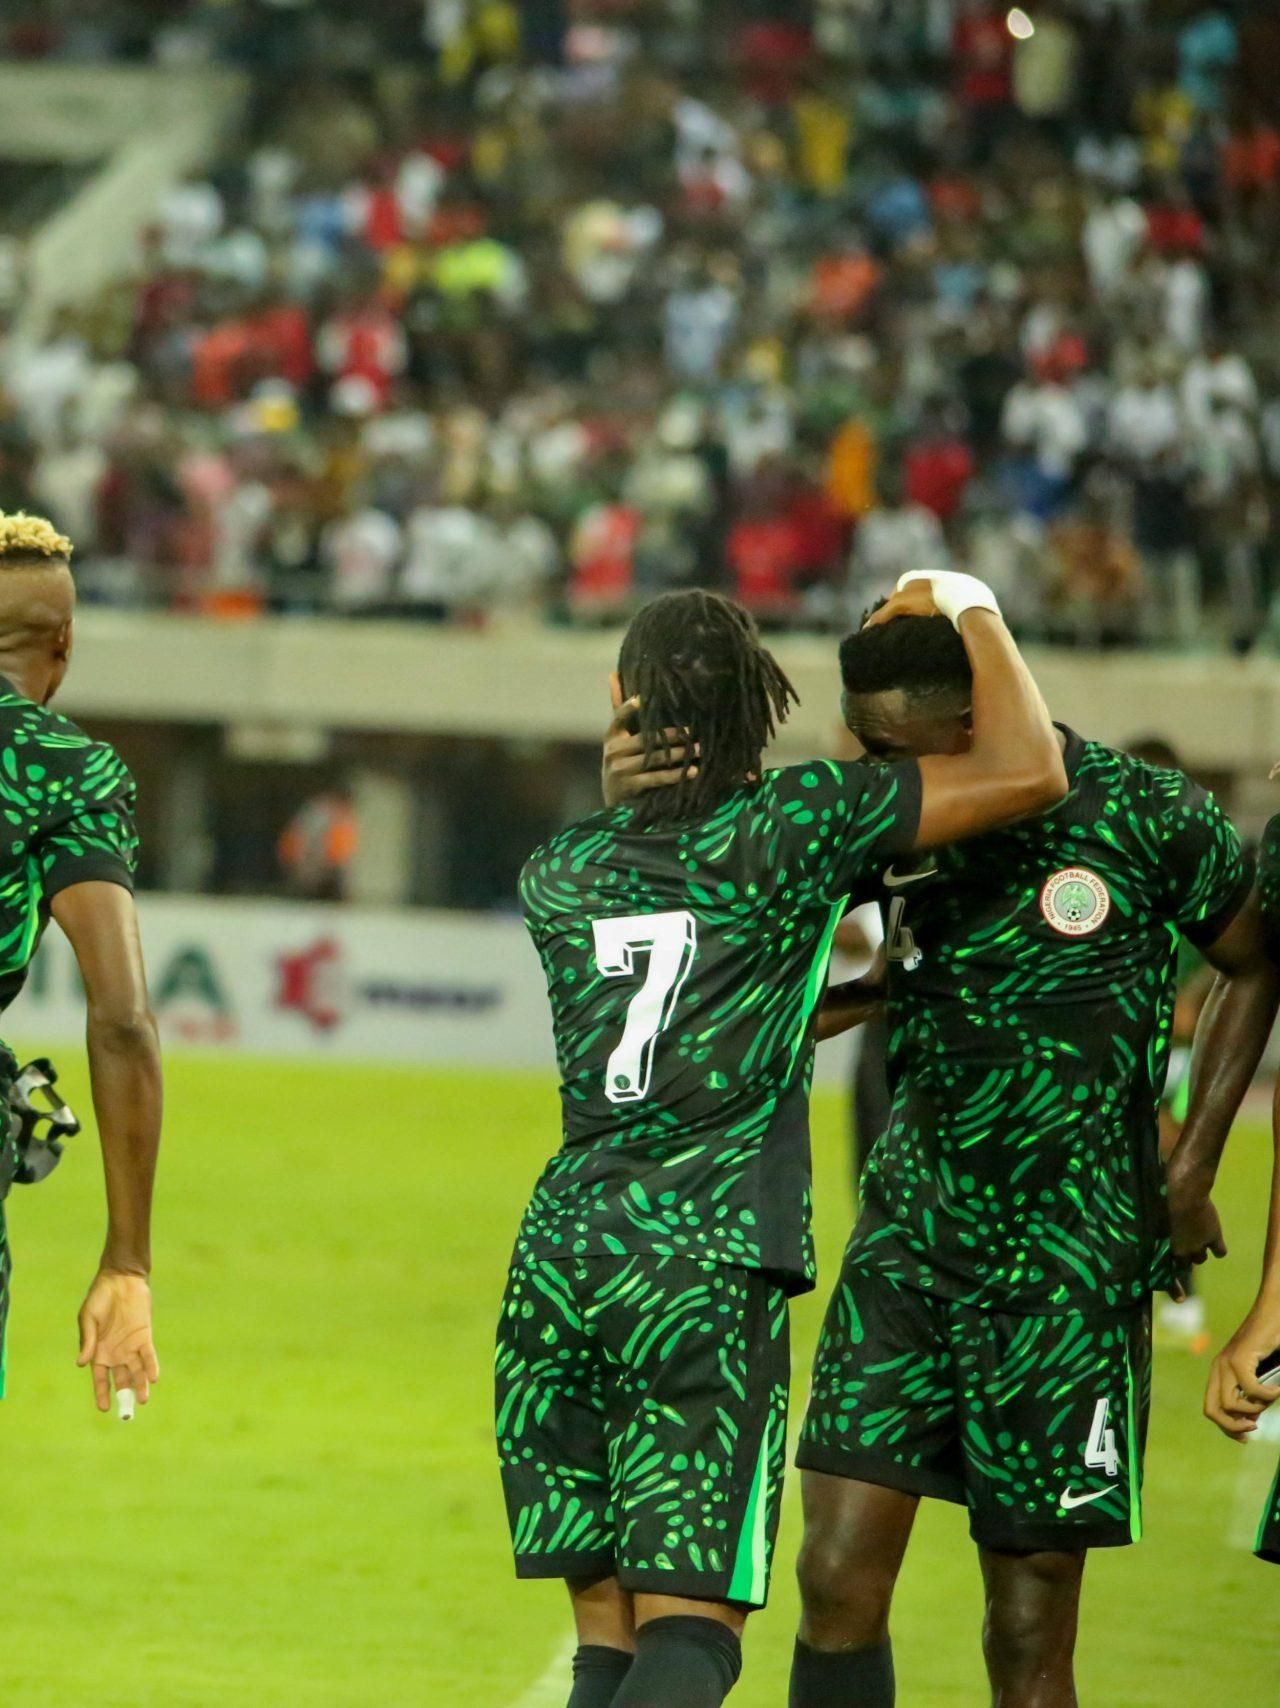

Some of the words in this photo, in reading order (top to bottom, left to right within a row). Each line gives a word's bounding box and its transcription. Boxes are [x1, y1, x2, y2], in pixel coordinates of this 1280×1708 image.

[886, 895, 923, 972] 4
[1044, 889, 1056, 920] NIGERIA
[1050, 871, 1089, 889] FOOTBALL
[1089, 878, 1107, 925] FEDERATION
[1064, 924, 1082, 932] 1945
[592, 911, 697, 1103] 7
[1084, 1398, 1120, 1476] 4
